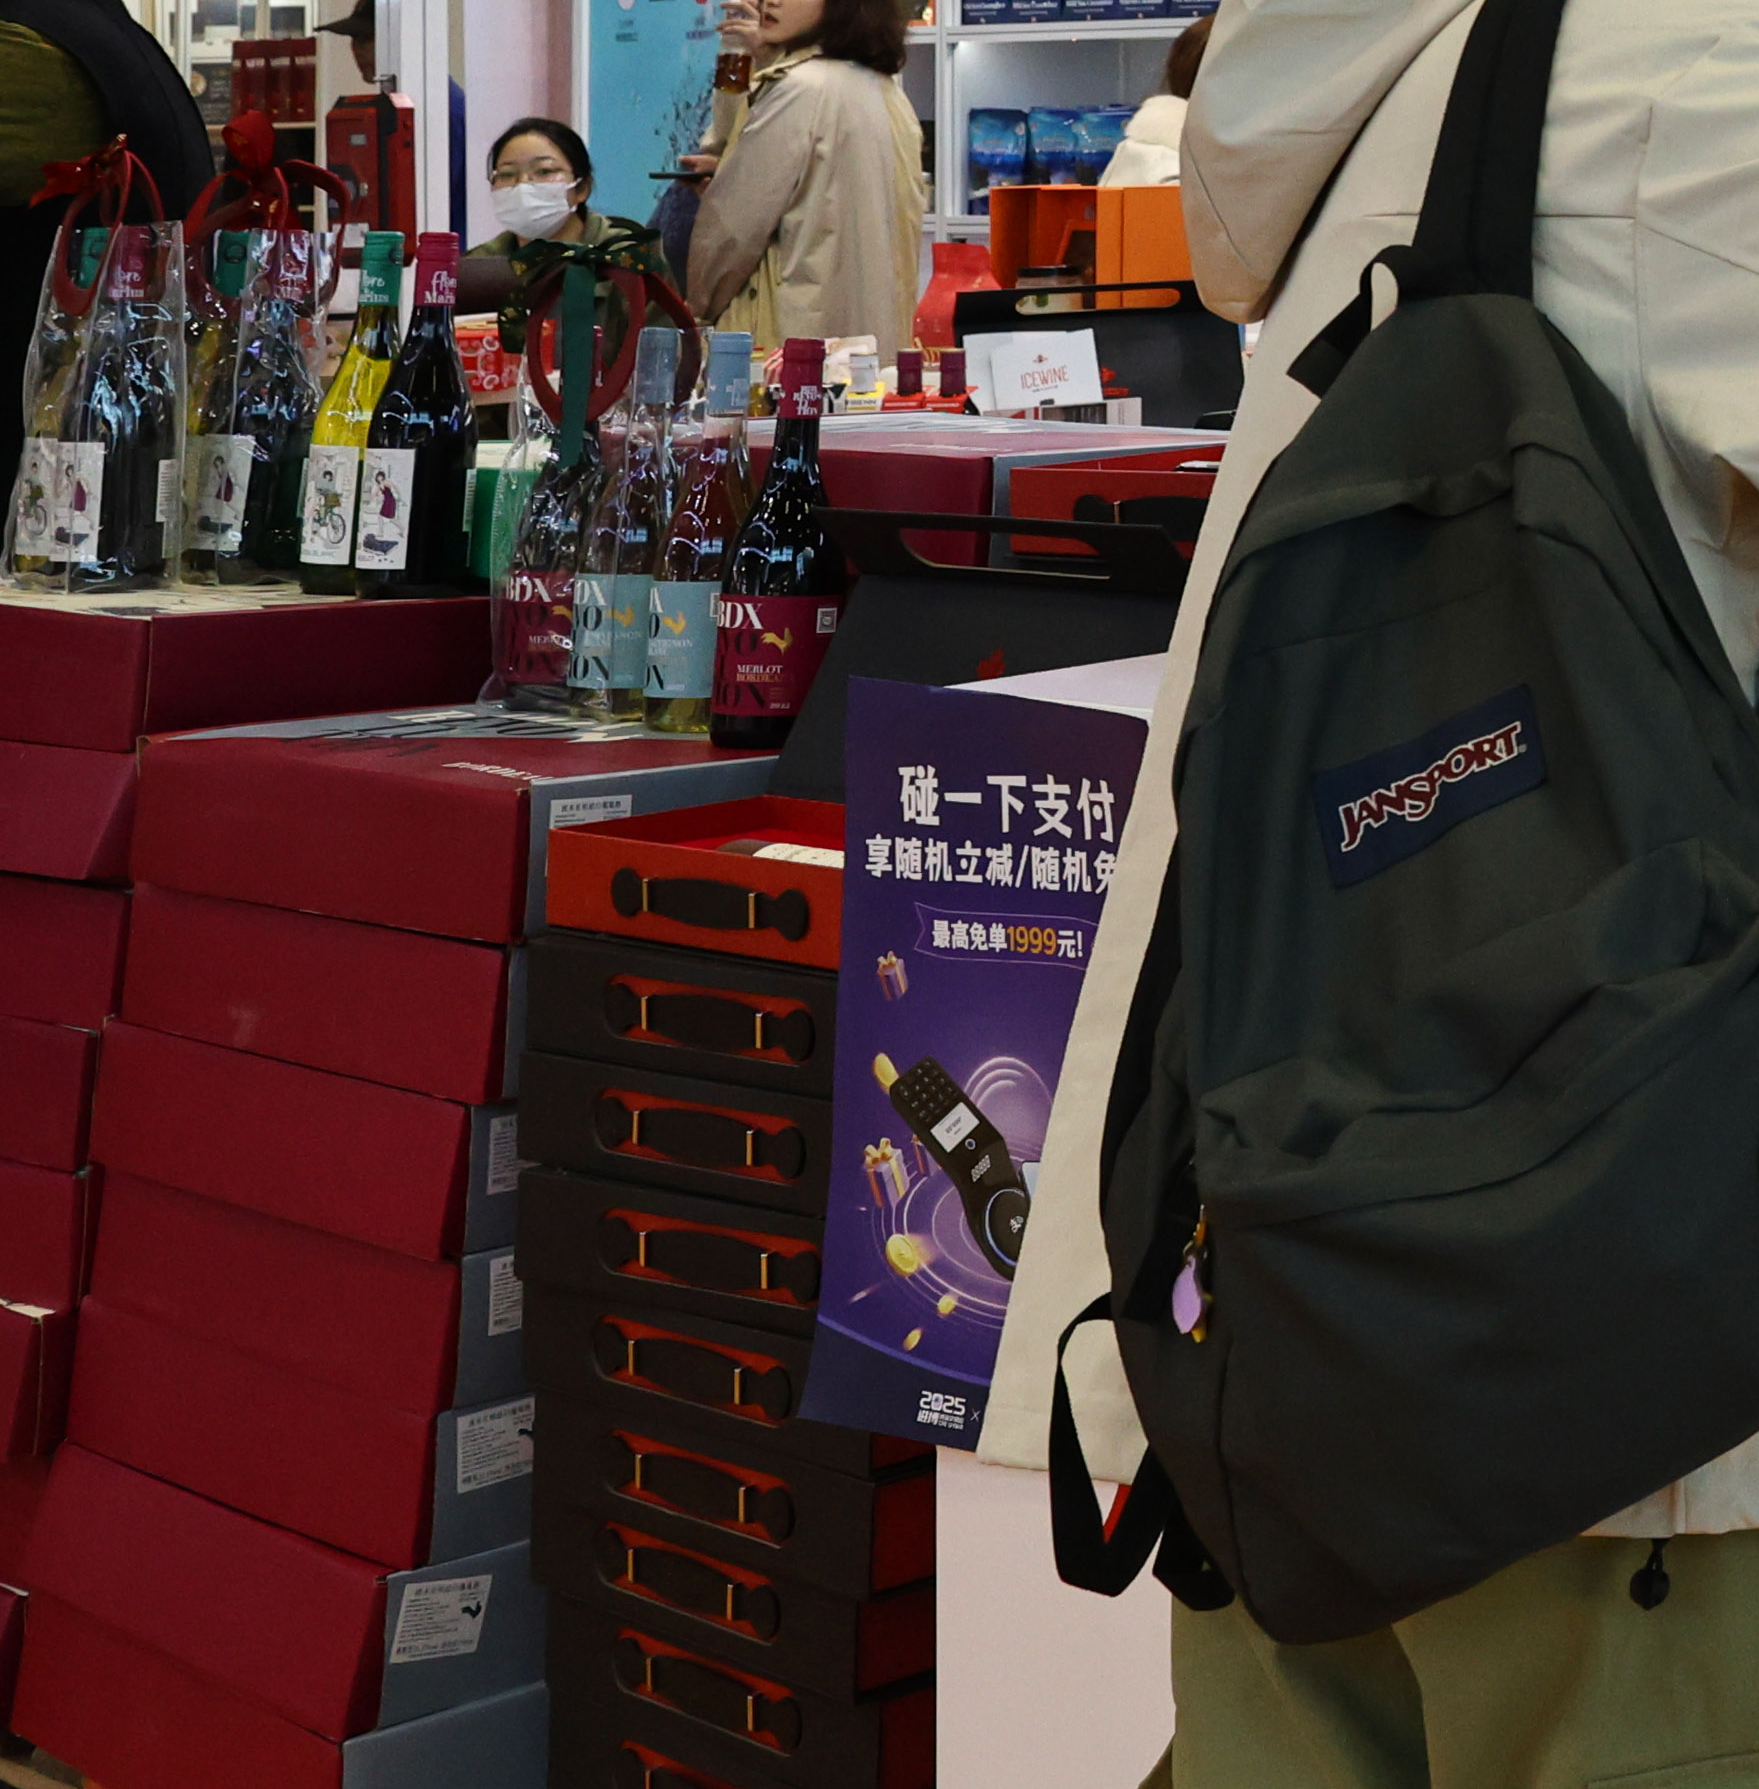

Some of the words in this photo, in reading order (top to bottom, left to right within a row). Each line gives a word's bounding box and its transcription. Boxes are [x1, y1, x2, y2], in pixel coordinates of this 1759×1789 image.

[1020, 364, 1069, 390] ICEWINE
[736, 664, 783, 675] MERLOT
[1338, 721, 1522, 853] JANSPORT
[898, 765, 1115, 843] 碰一下支付
[919, 1390, 967, 1416] 2025
